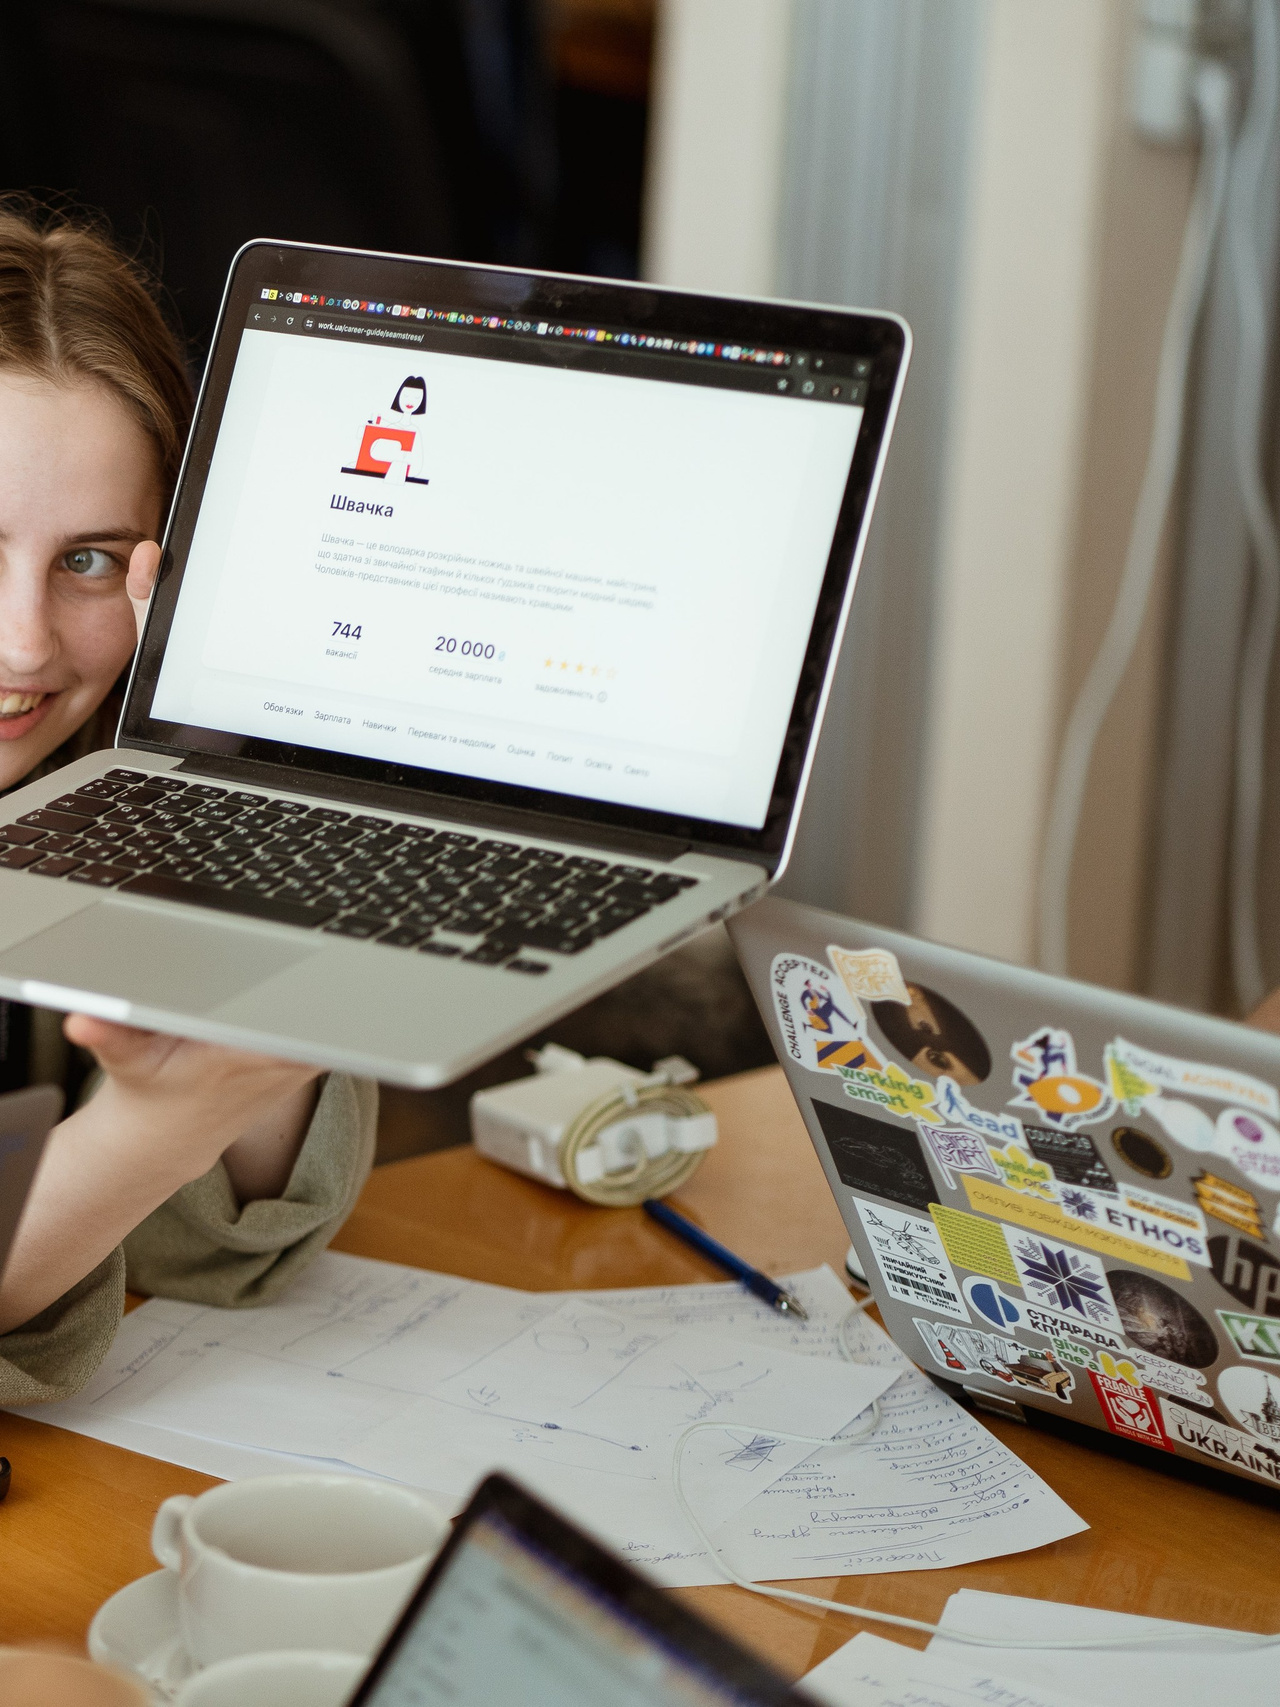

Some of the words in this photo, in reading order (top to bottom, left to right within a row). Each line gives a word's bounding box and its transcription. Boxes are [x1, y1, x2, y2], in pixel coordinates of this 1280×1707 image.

[318, 322, 424, 343] work.ua/career-guide/seamstress/
[330, 494, 395, 518] Швачка
[321, 533, 355, 546] Швачка
[366, 541, 377, 552] це
[379, 543, 426, 558] володарка
[332, 553, 363, 565] здатна
[314, 563, 421, 590] Чоловіків-представників
[331, 621, 363, 641] 744
[325, 647, 359, 661] вакансії
[435, 636, 458, 654] 20
[461, 640, 496, 660] 000
[263, 701, 304, 717] Обов'язки
[313, 710, 352, 726] Зарплата
[362, 719, 398, 733] Навички
[407, 726, 447, 742] Переваги
[774, 959, 831, 988] ACCEPTED
[776, 990, 802, 1060] CHALLENGE
[835, 1065, 925, 1100] working
[845, 1084, 909, 1109] smart
[1023, 1177, 1052, 1193] one
[1105, 1207, 1203, 1256] ETHOS
[880, 1254, 927, 1275] ЗВИЧАЙНИЙ
[883, 1262, 946, 1288] ПЕРШОКУРСНИК
[1223, 1235, 1280, 1314] hp
[1027, 1308, 1121, 1350] СТУДРАДА
[1031, 1321, 1060, 1338] КПІ
[1053, 1337, 1091, 1357] give
[1058, 1350, 1086, 1366] me
[1088, 1362, 1099, 1372] a
[1134, 1352, 1167, 1370] KEEP
[1168, 1364, 1205, 1384] CALM
[1095, 1374, 1147, 1401] FRAGILE
[1156, 1370, 1185, 1385] AND
[1115, 1426, 1136, 1439] HANDLE
[1150, 1435, 1166, 1447] CARE
[1169, 1407, 1256, 1457] SHAPE
